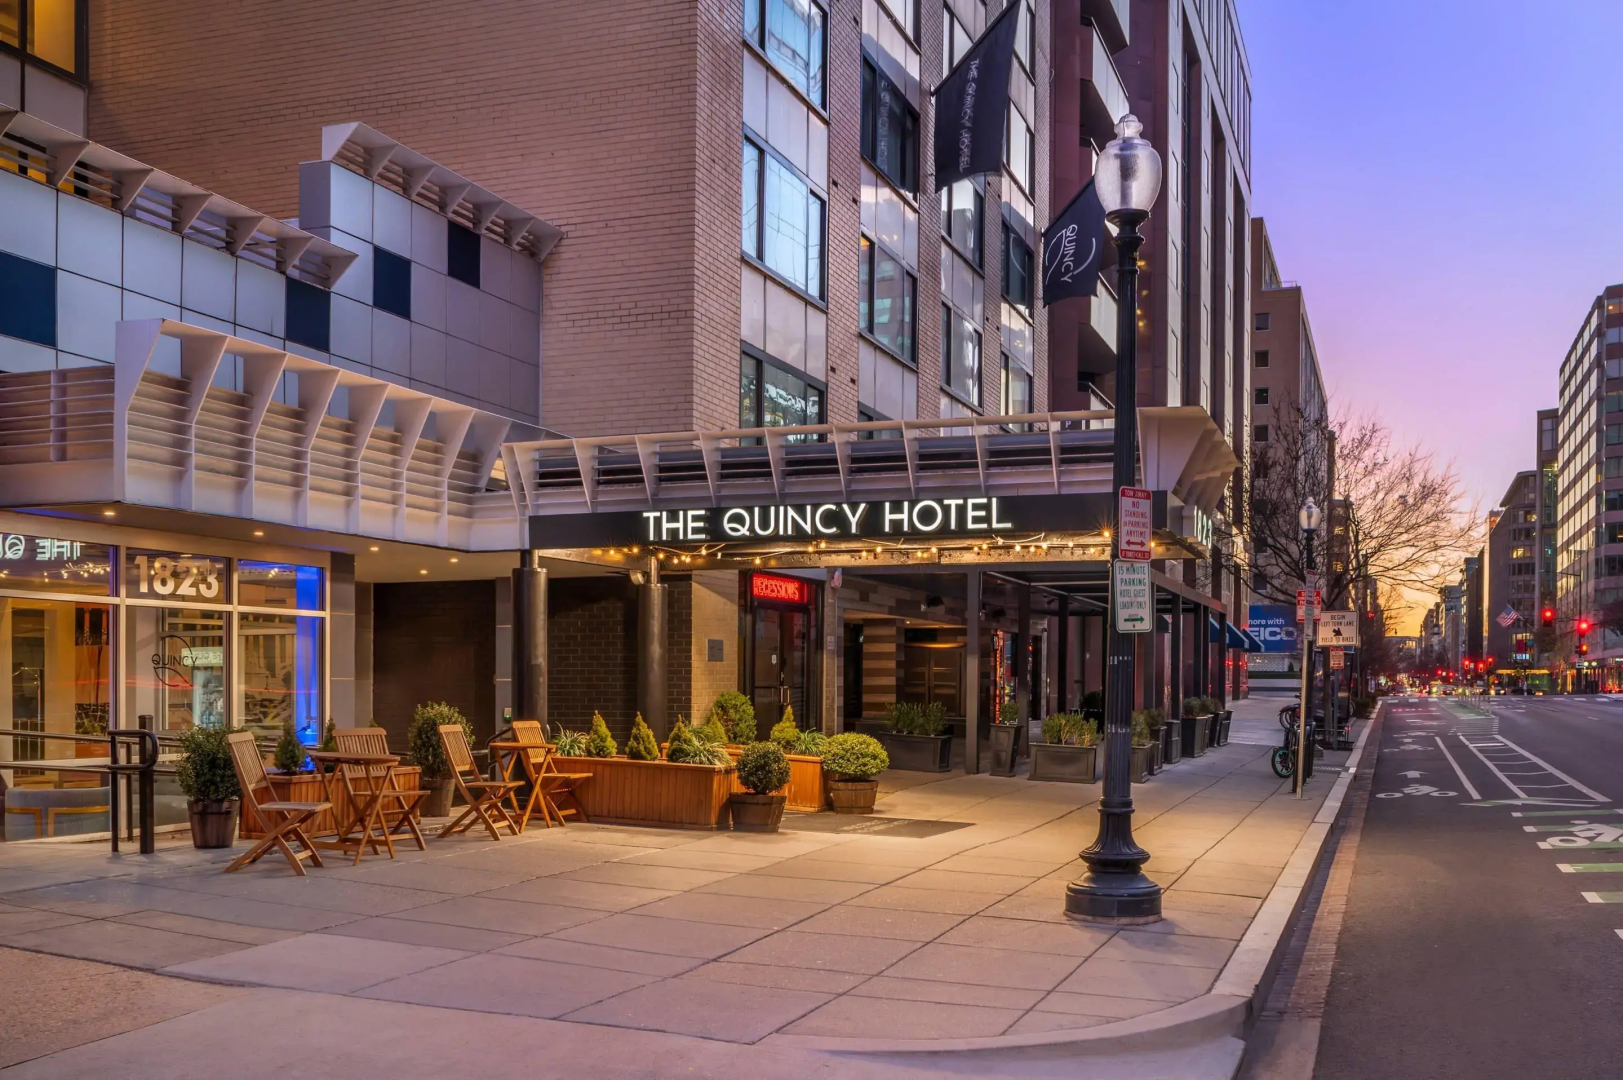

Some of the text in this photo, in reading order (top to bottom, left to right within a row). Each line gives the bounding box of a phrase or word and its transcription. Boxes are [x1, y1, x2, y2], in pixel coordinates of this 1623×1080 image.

[960, 82, 977, 127] QUINCY
[959, 129, 972, 173] HOTEL
[1061, 224, 1078, 283] QUINCY
[1131, 500, 1140, 508] NO
[643, 497, 1012, 541] THE QUINCY HOTEL
[1124, 509, 1148, 519] STANDING
[1128, 520, 1149, 530] PARKING
[1193, 505, 1213, 550] 1823
[1125, 529, 1146, 539] ANYTIME
[134, 555, 220, 598] 1823
[1118, 566, 1146, 575] 15 MINUTE
[753, 577, 799, 600] RECESSIONS
[1120, 578, 1147, 587] PARKING
[1120, 589, 1146, 598] HOTEL GUEST
[1267, 617, 1285, 625] with
[151, 653, 198, 668] QUINCY
